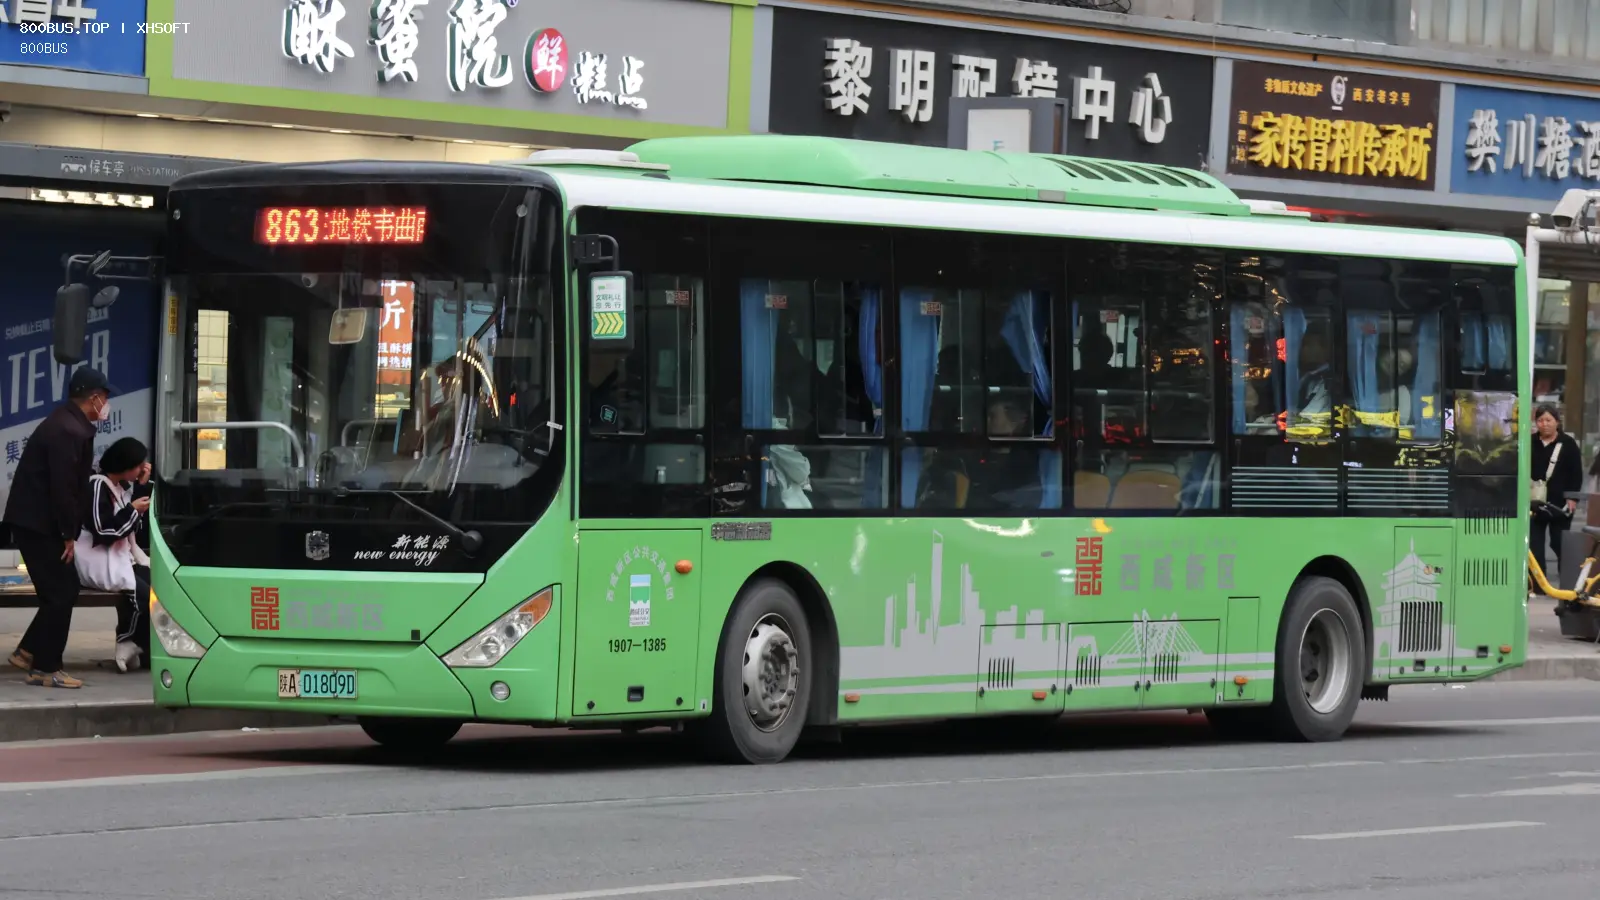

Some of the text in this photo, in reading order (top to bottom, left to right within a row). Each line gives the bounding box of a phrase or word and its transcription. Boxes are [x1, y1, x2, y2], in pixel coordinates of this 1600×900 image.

[571, 51, 648, 109] 糕点
[823, 37, 1173, 144] 黎明配镜中心
[1352, 87, 1411, 107] 西安老字号
[1465, 109, 1600, 181] 樊川糖酒
[89, 159, 125, 177] 候车亭
[391, 534, 450, 550] 新能源
[353, 550, 441, 567] new energy
